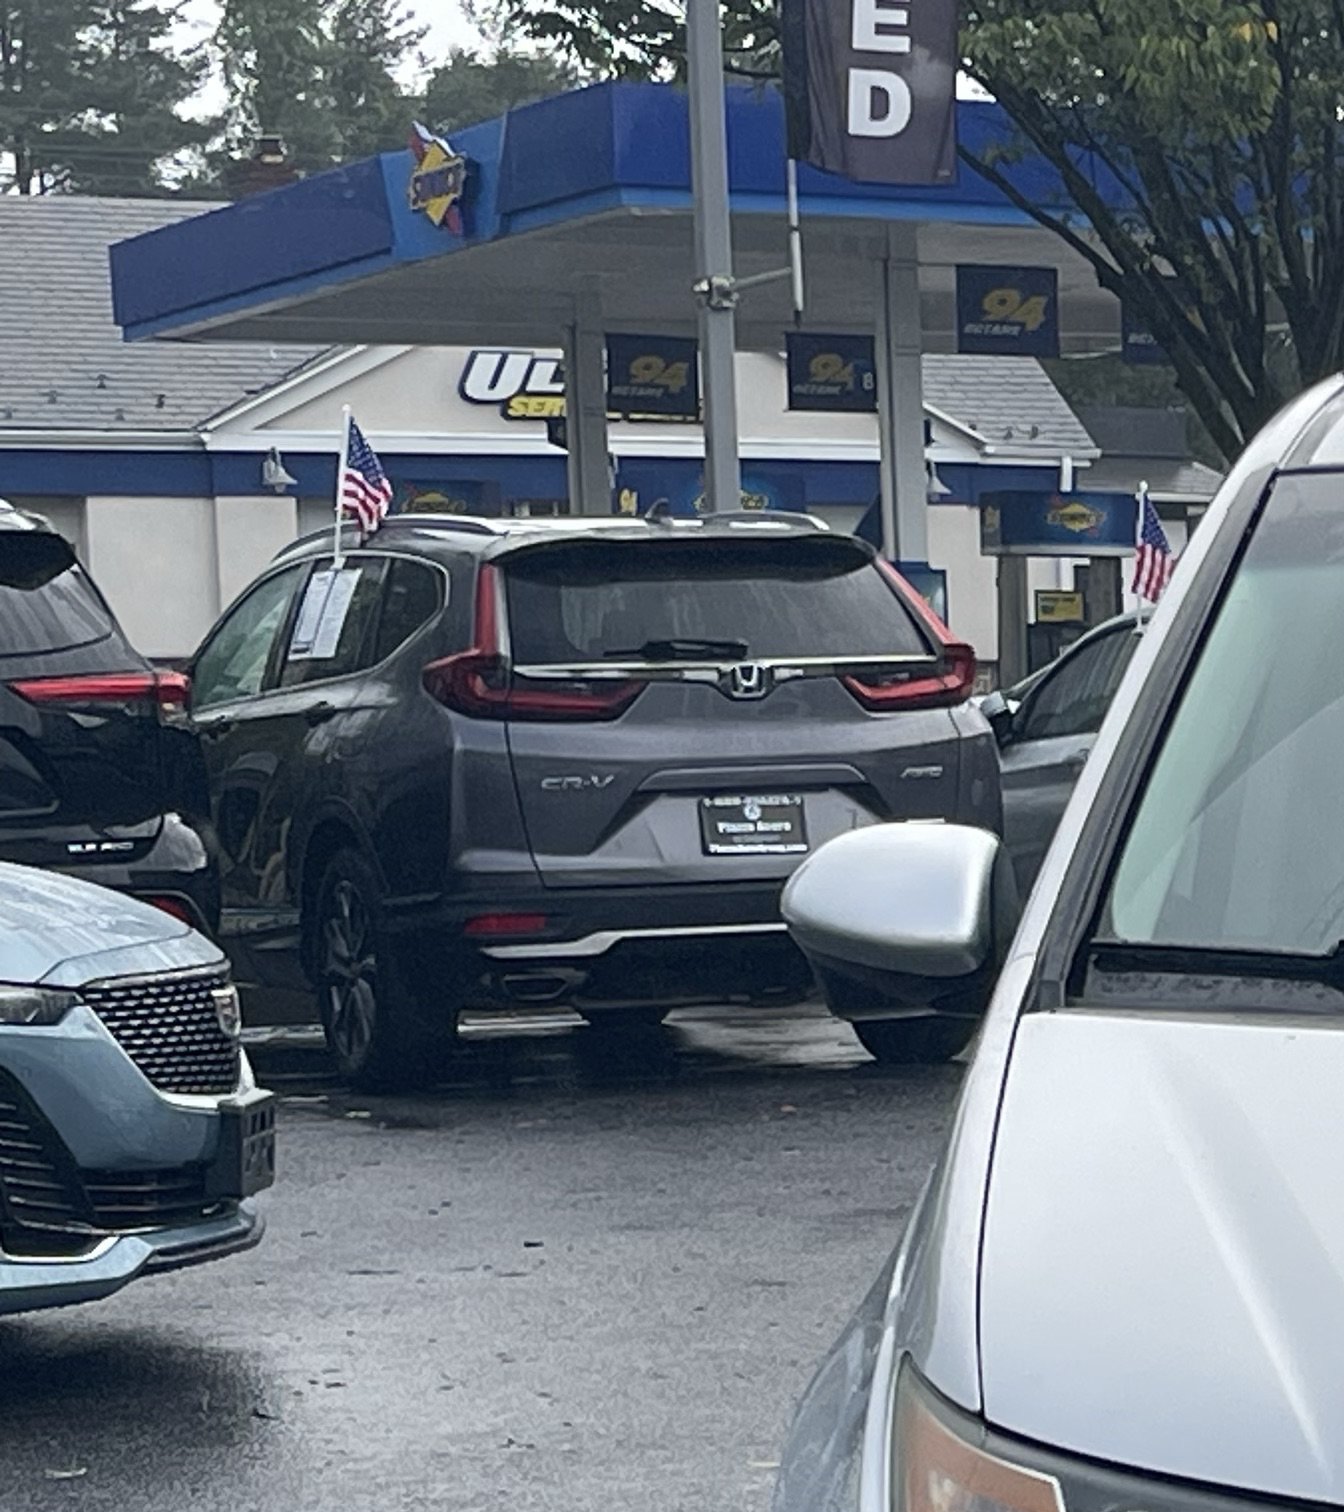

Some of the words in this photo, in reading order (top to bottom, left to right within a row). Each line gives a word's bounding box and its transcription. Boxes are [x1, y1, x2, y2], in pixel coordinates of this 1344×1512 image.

[982, 288, 1048, 332] 94
[629, 355, 690, 394] 94
[541, 774, 615, 791] CR-V
